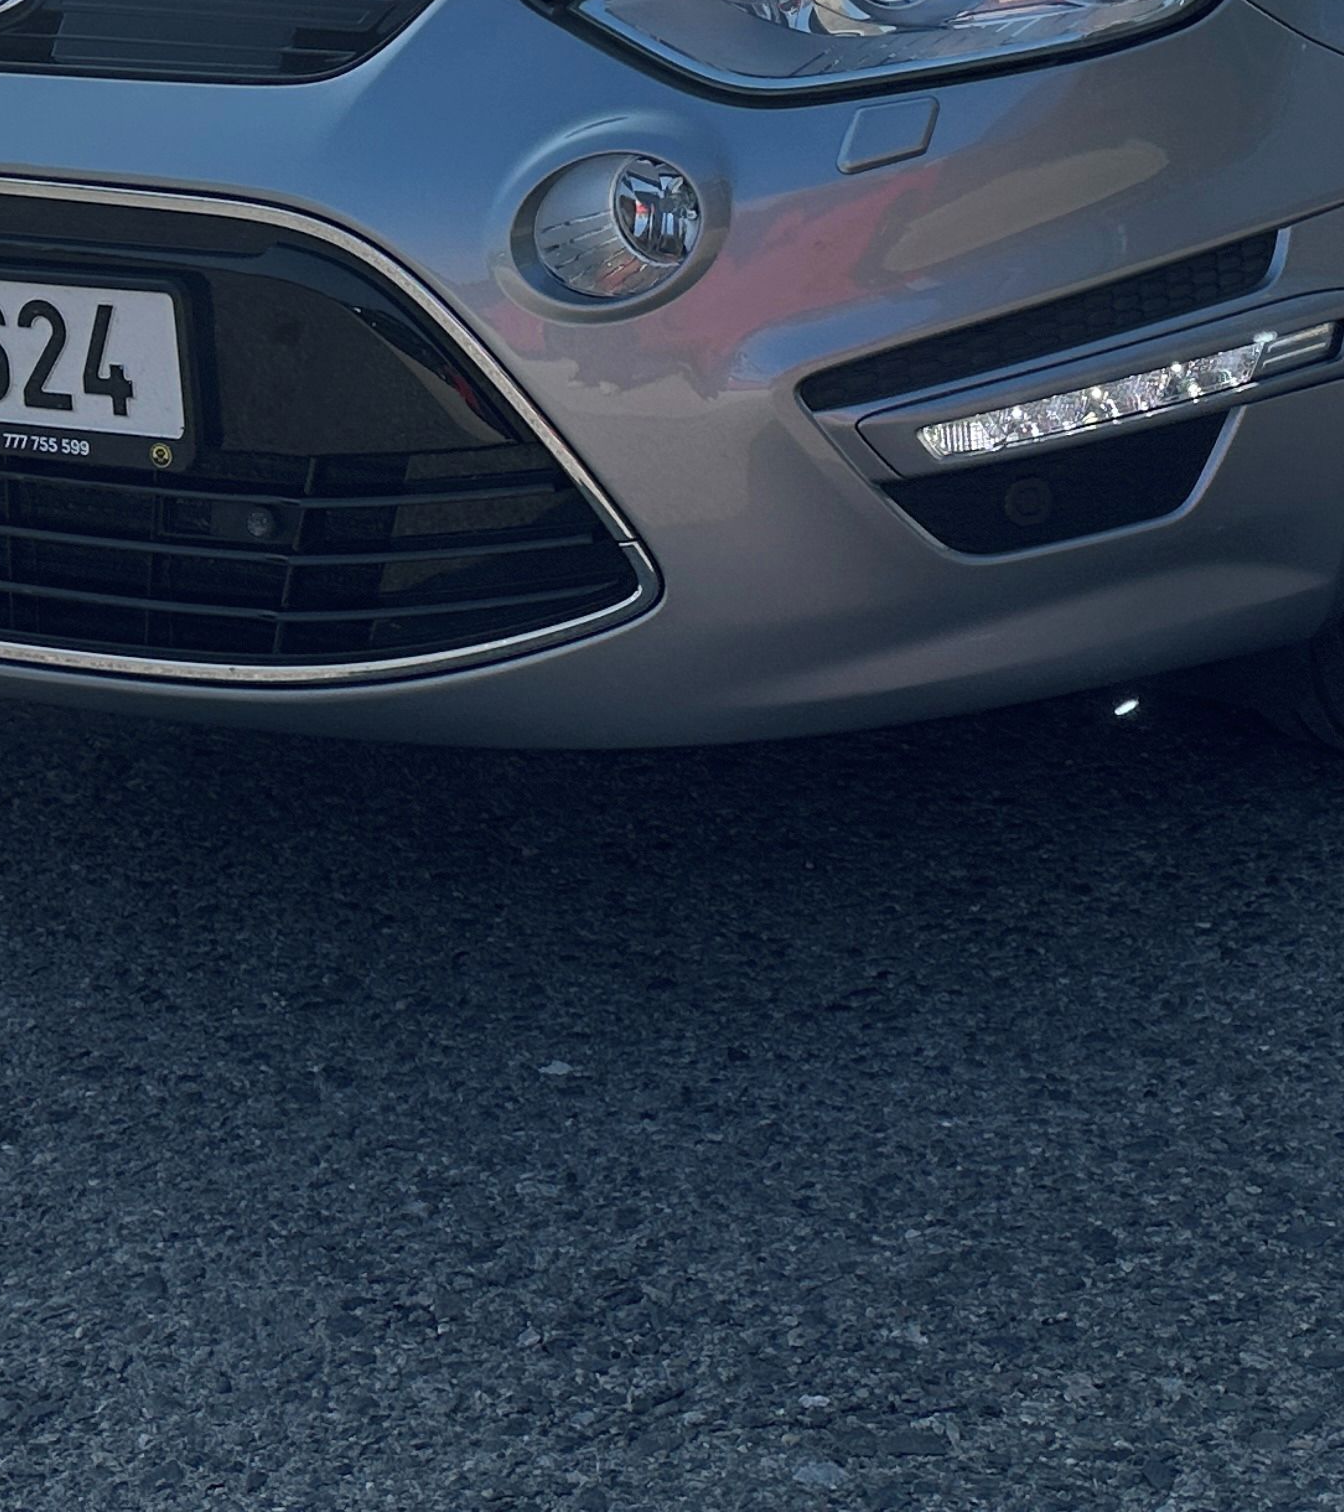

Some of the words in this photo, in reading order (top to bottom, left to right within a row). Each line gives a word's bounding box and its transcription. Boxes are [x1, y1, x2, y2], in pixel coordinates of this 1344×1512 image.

[2, 432, 28, 450] 777
[31, 435, 58, 453] 755
[61, 438, 90, 456] 599
